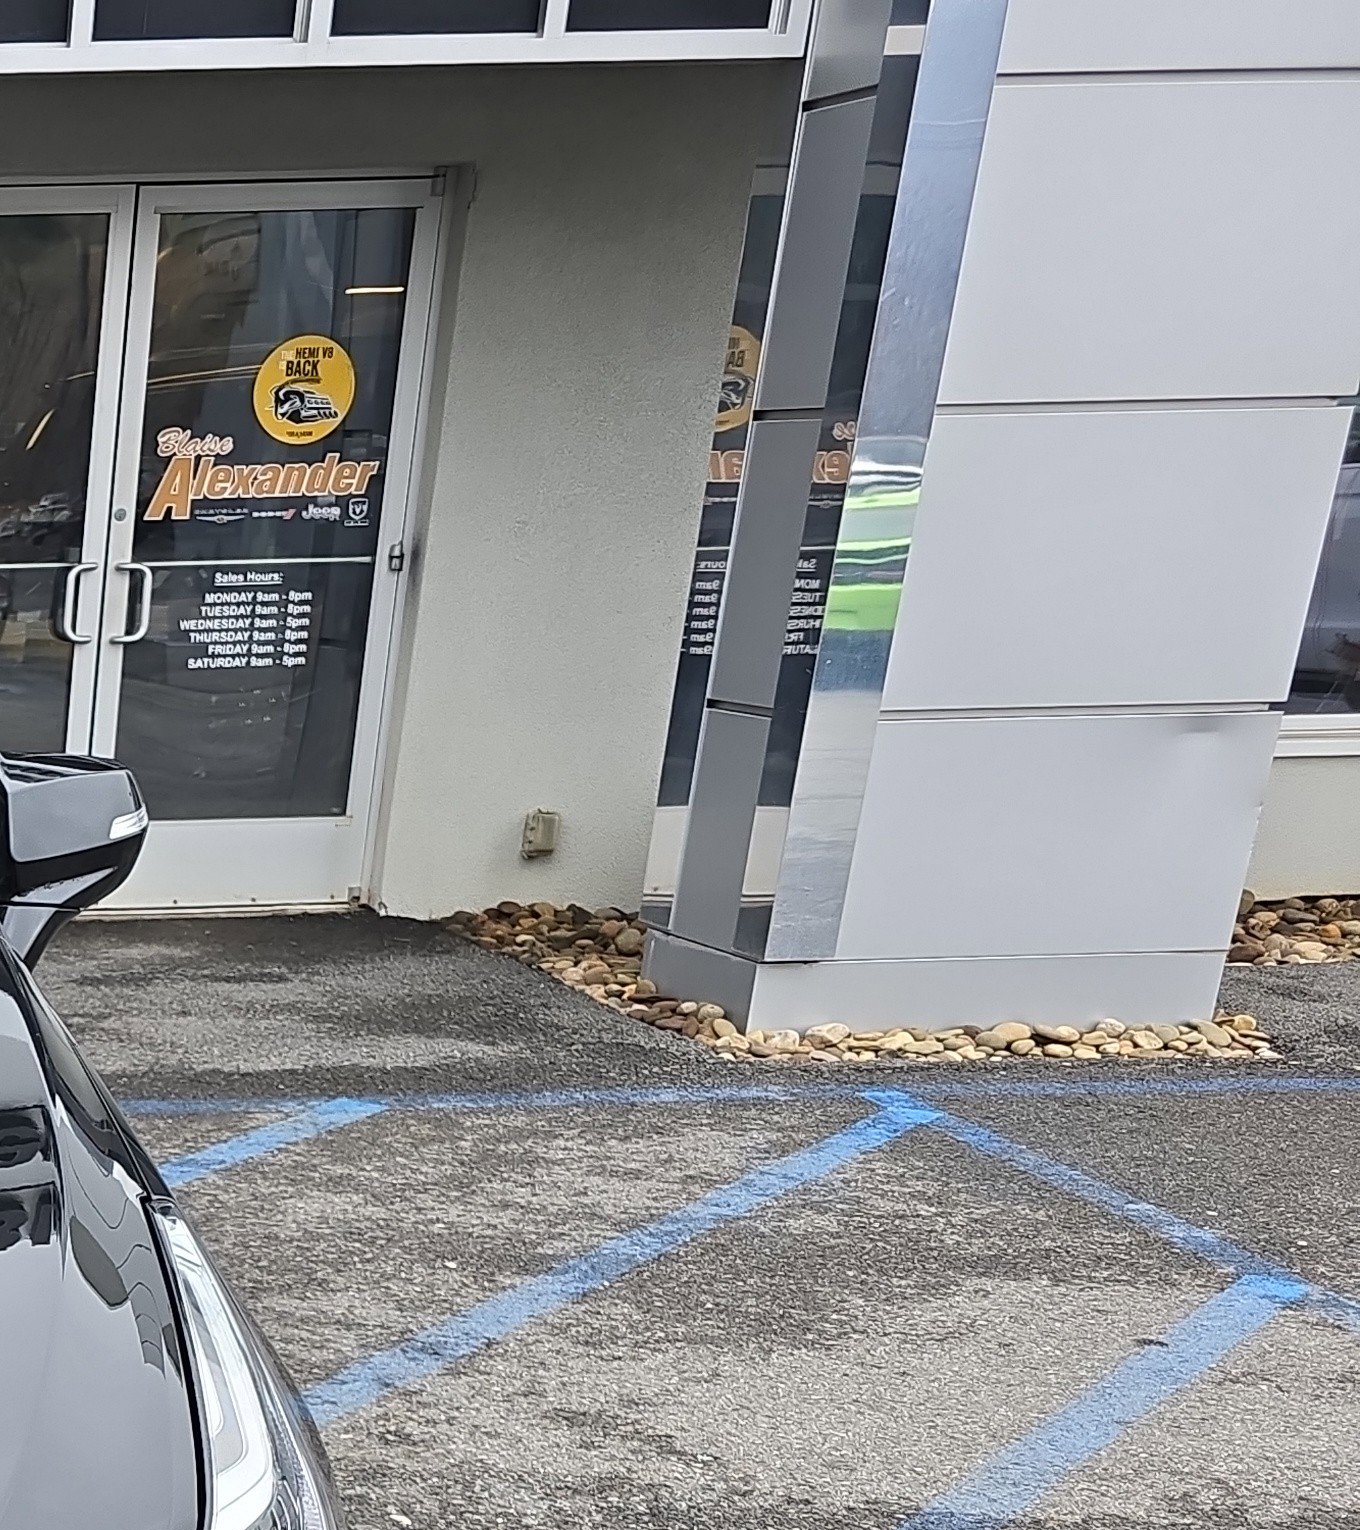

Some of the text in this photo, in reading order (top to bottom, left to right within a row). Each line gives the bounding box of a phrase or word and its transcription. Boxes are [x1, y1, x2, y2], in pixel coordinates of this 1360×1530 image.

[294, 347, 320, 360] HEMI
[321, 346, 334, 359] V8
[285, 359, 321, 377] BACK
[156, 427, 234, 456] Blaise
[143, 452, 380, 521] Alexander
[301, 504, 341, 521] Jeep
[214, 570, 284, 584] Sales Hours:
[204, 591, 254, 604] MONDAY
[255, 591, 279, 602] 9am
[199, 604, 253, 617] TUESDAY
[254, 604, 278, 615] 9am
[179, 617, 252, 630] WEDNESDAY
[253, 617, 277, 628] 9am
[285, 616, 310, 629] 5pm
[189, 630, 251, 643] THURSDAY
[252, 630, 276, 641] 9am
[207, 643, 249, 656] FRIDAY
[251, 643, 274, 654] 9am
[187, 656, 248, 669] SATURDAY
[249, 656, 273, 667] 9am
[282, 655, 306, 668] 5pm
